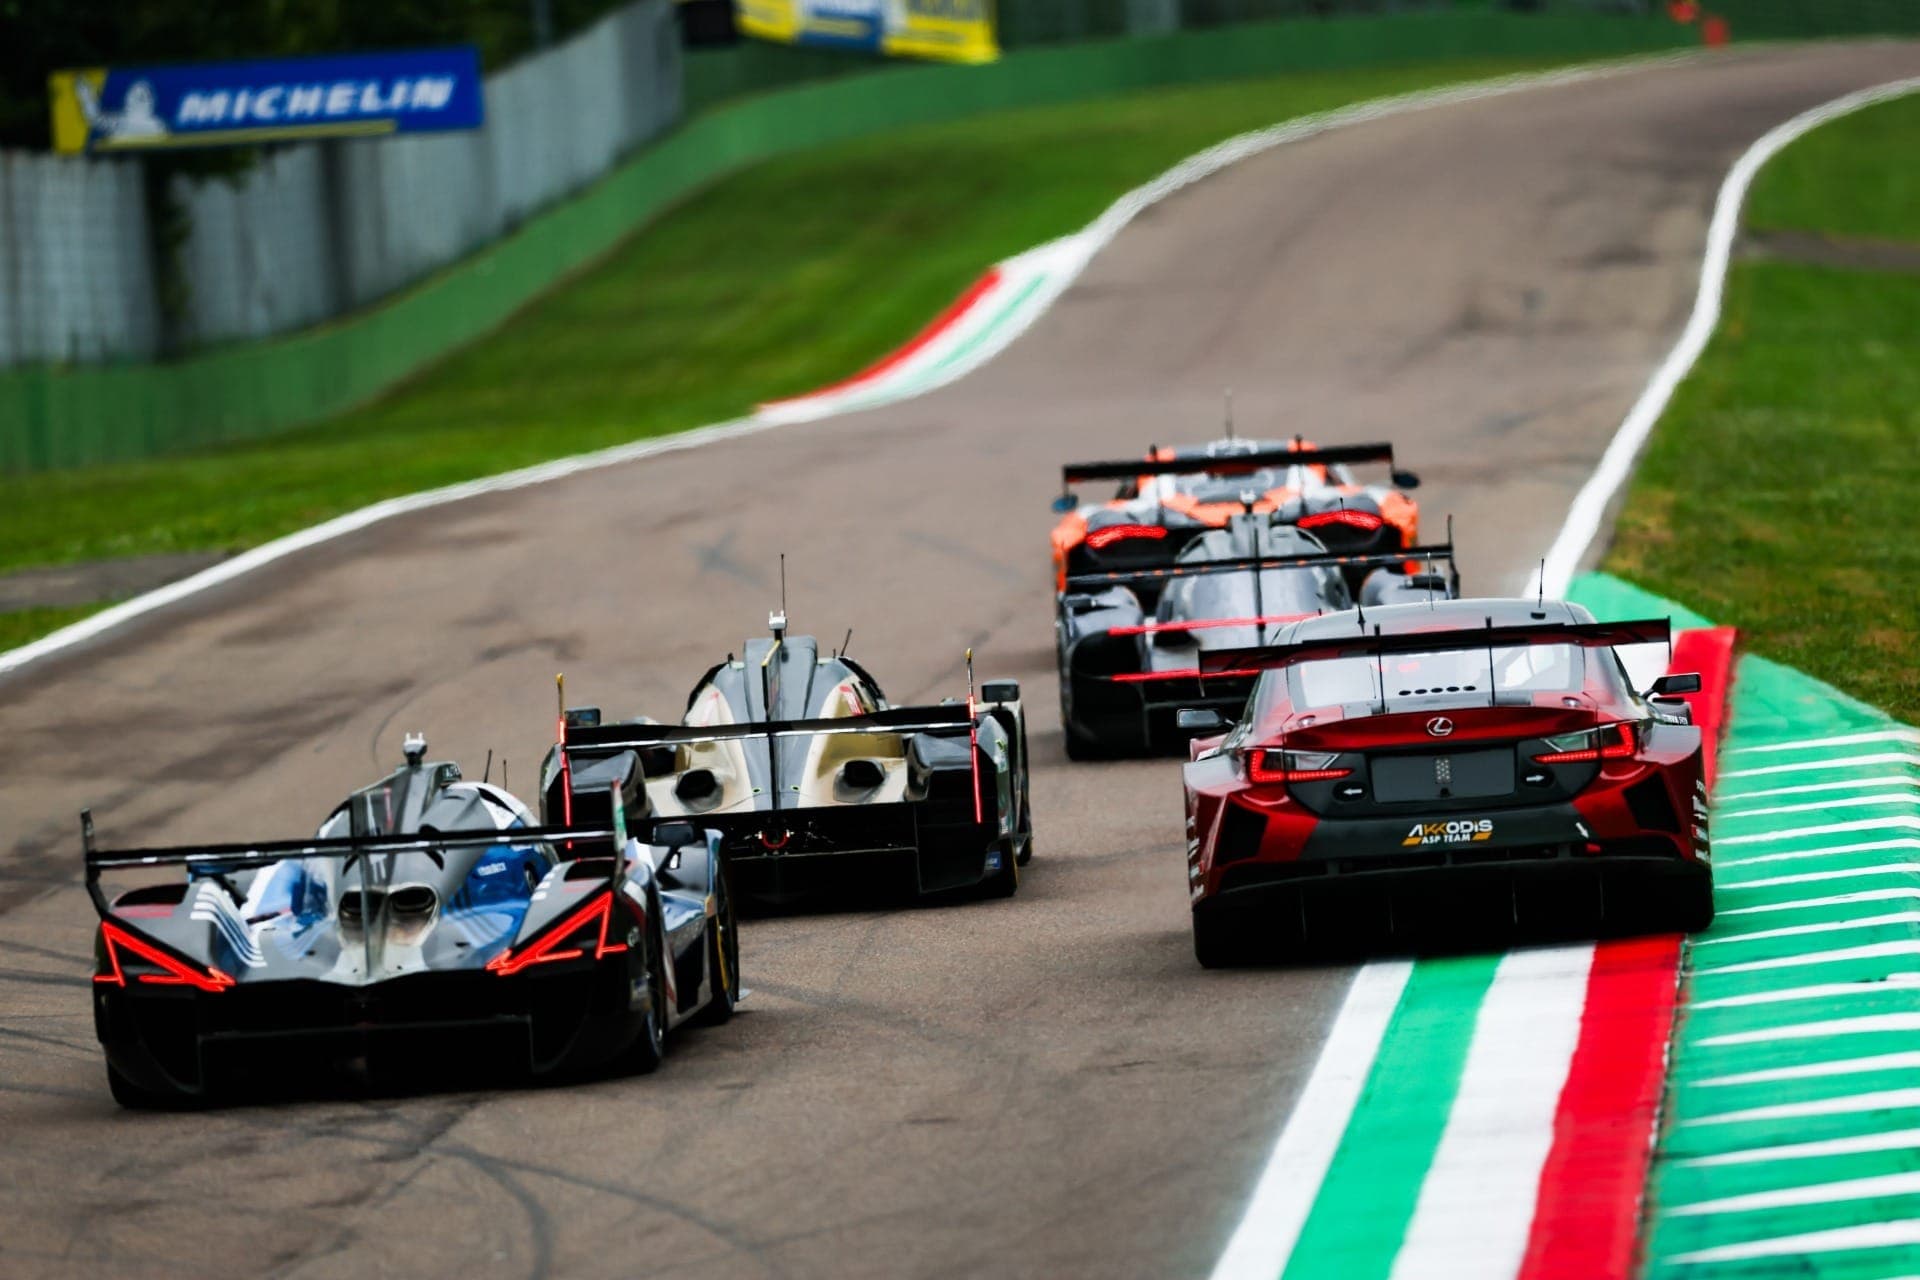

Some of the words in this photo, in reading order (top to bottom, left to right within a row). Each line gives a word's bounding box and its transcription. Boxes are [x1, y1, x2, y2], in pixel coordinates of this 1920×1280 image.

[178, 78, 455, 122] MICHELIN
[1421, 835, 1441, 845] ASP
[1444, 833, 1471, 843] TEAM
